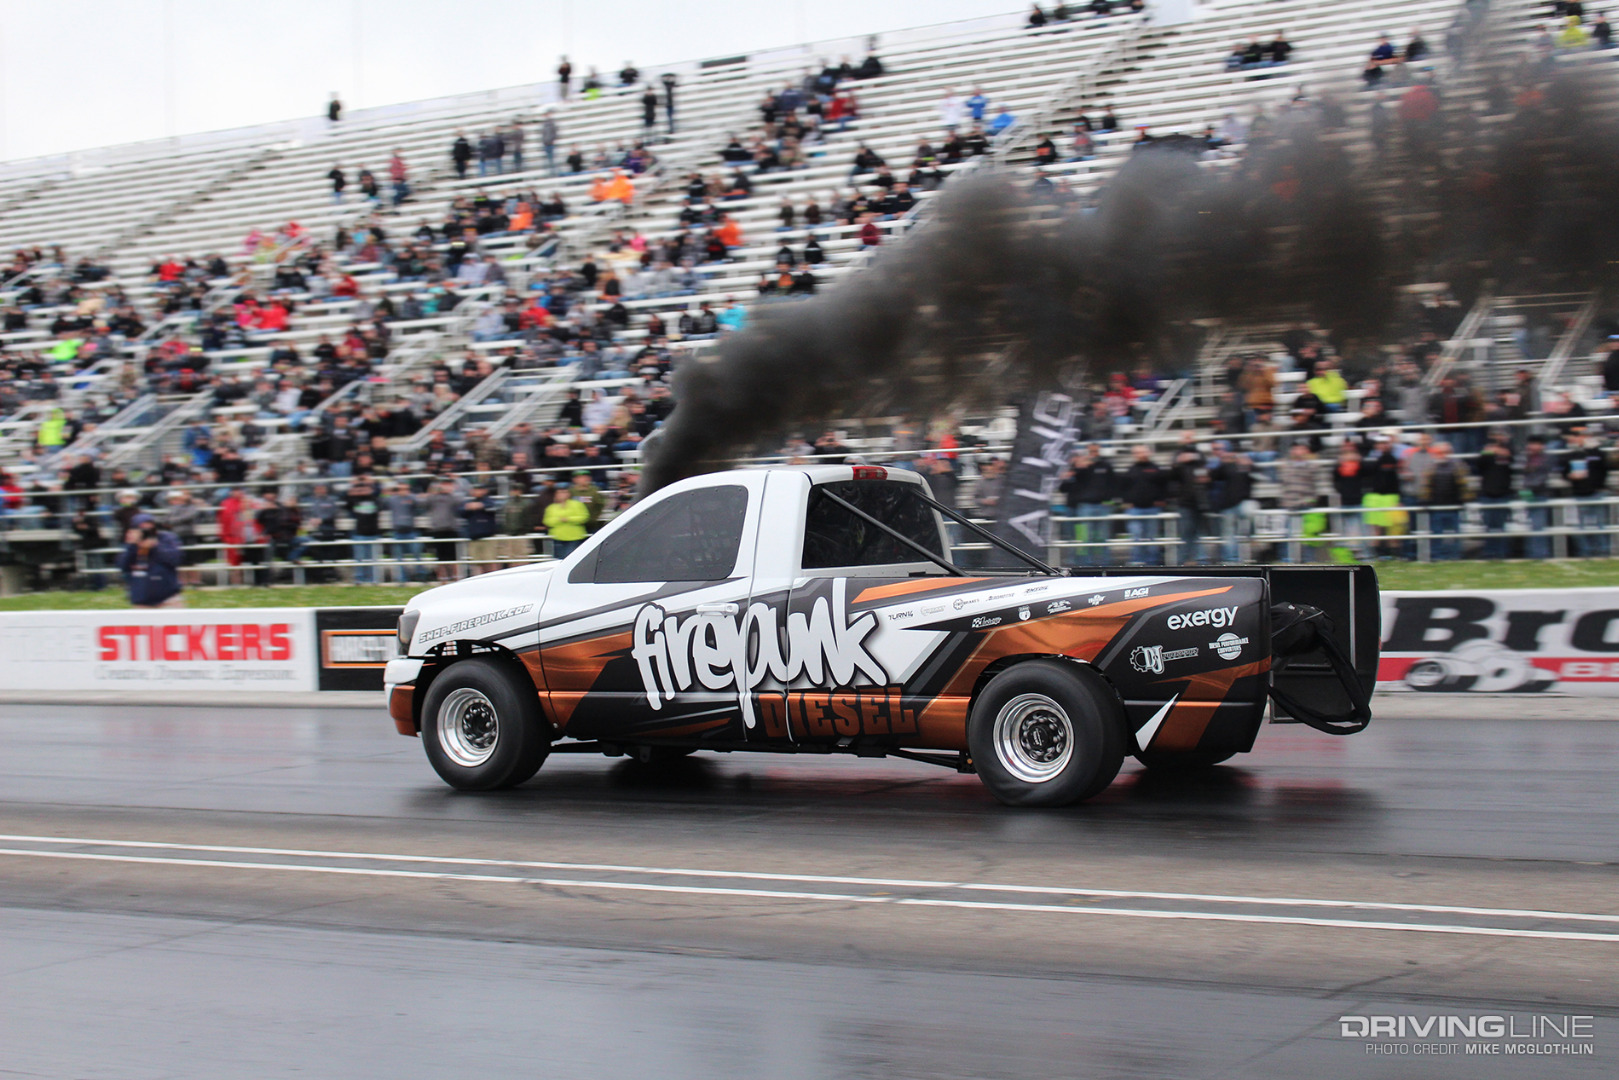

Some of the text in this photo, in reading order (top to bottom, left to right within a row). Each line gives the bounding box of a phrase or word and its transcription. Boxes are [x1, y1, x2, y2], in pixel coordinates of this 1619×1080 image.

[419, 603, 534, 643] SHOP.FIREPUNK.COM
[1167, 606, 1239, 631] exergy
[97, 624, 294, 661] STICKERS
[631, 577, 890, 728] firepunk
[757, 687, 918, 738] DIESEL
